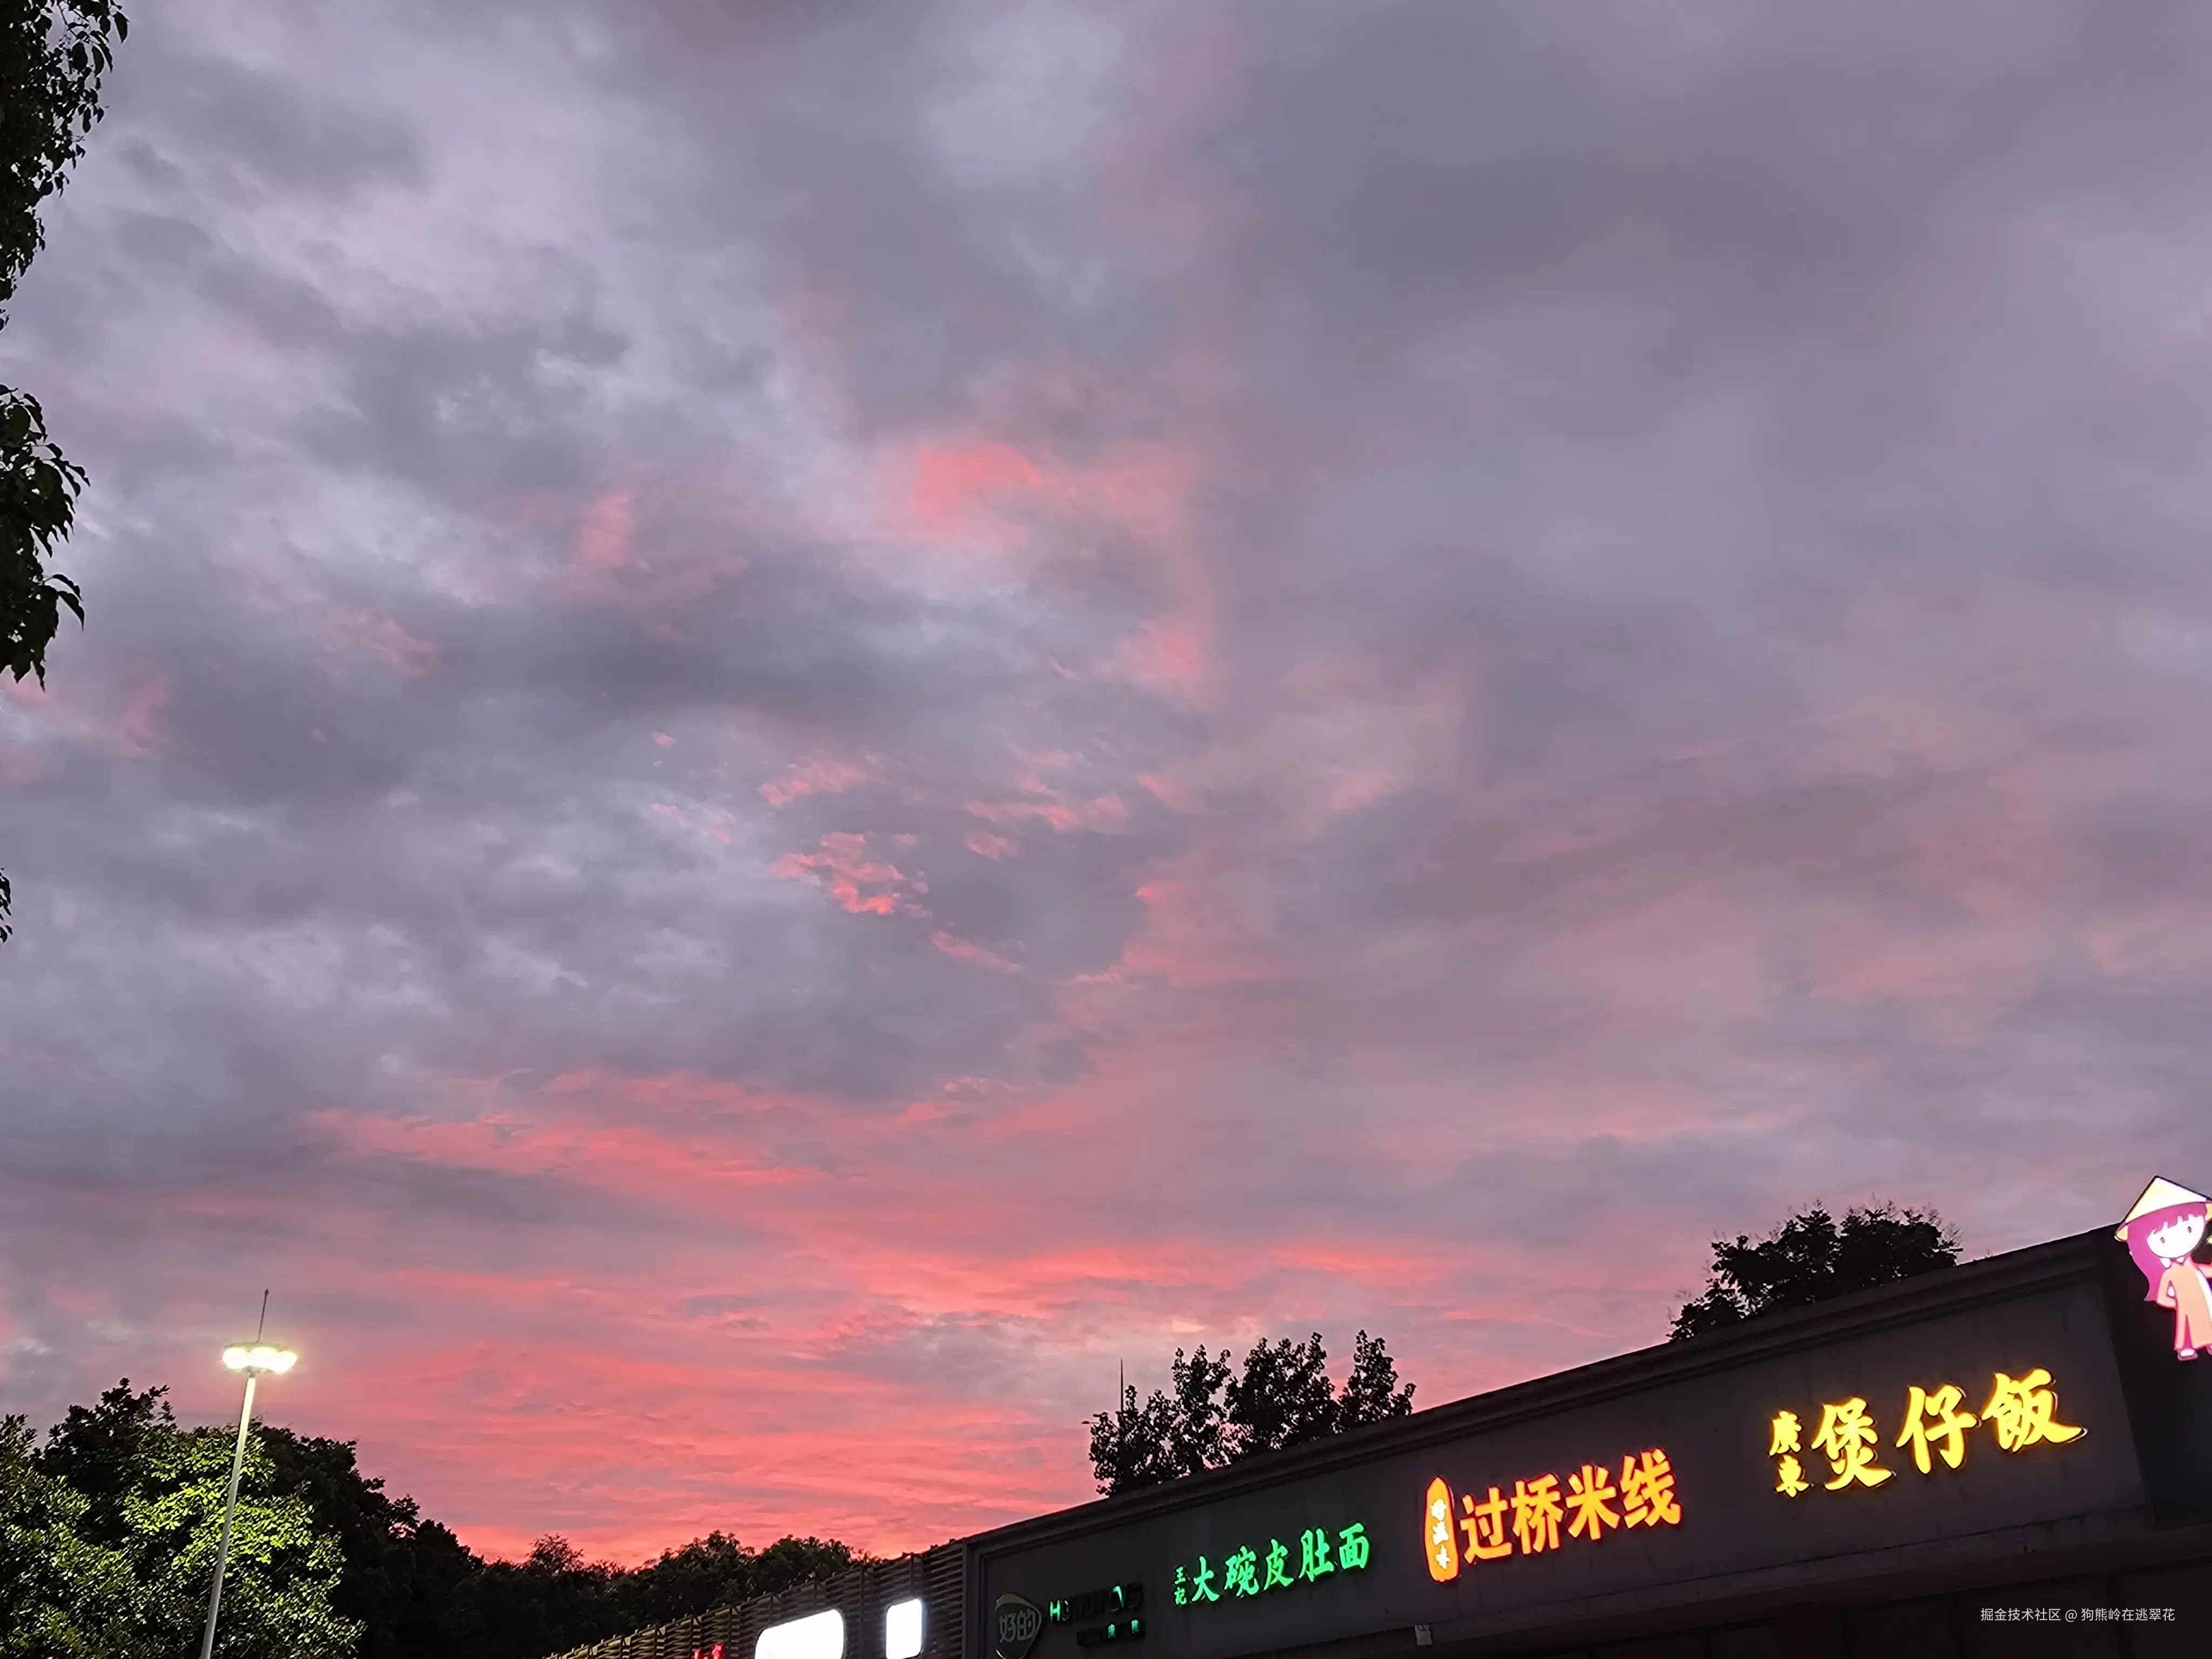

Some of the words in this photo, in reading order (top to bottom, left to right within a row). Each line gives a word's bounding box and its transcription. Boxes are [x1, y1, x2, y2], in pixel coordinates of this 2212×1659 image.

[1460, 1448, 1682, 1565] 过桥米线
[1191, 1522, 1370, 1602] 大碗皮肚面
